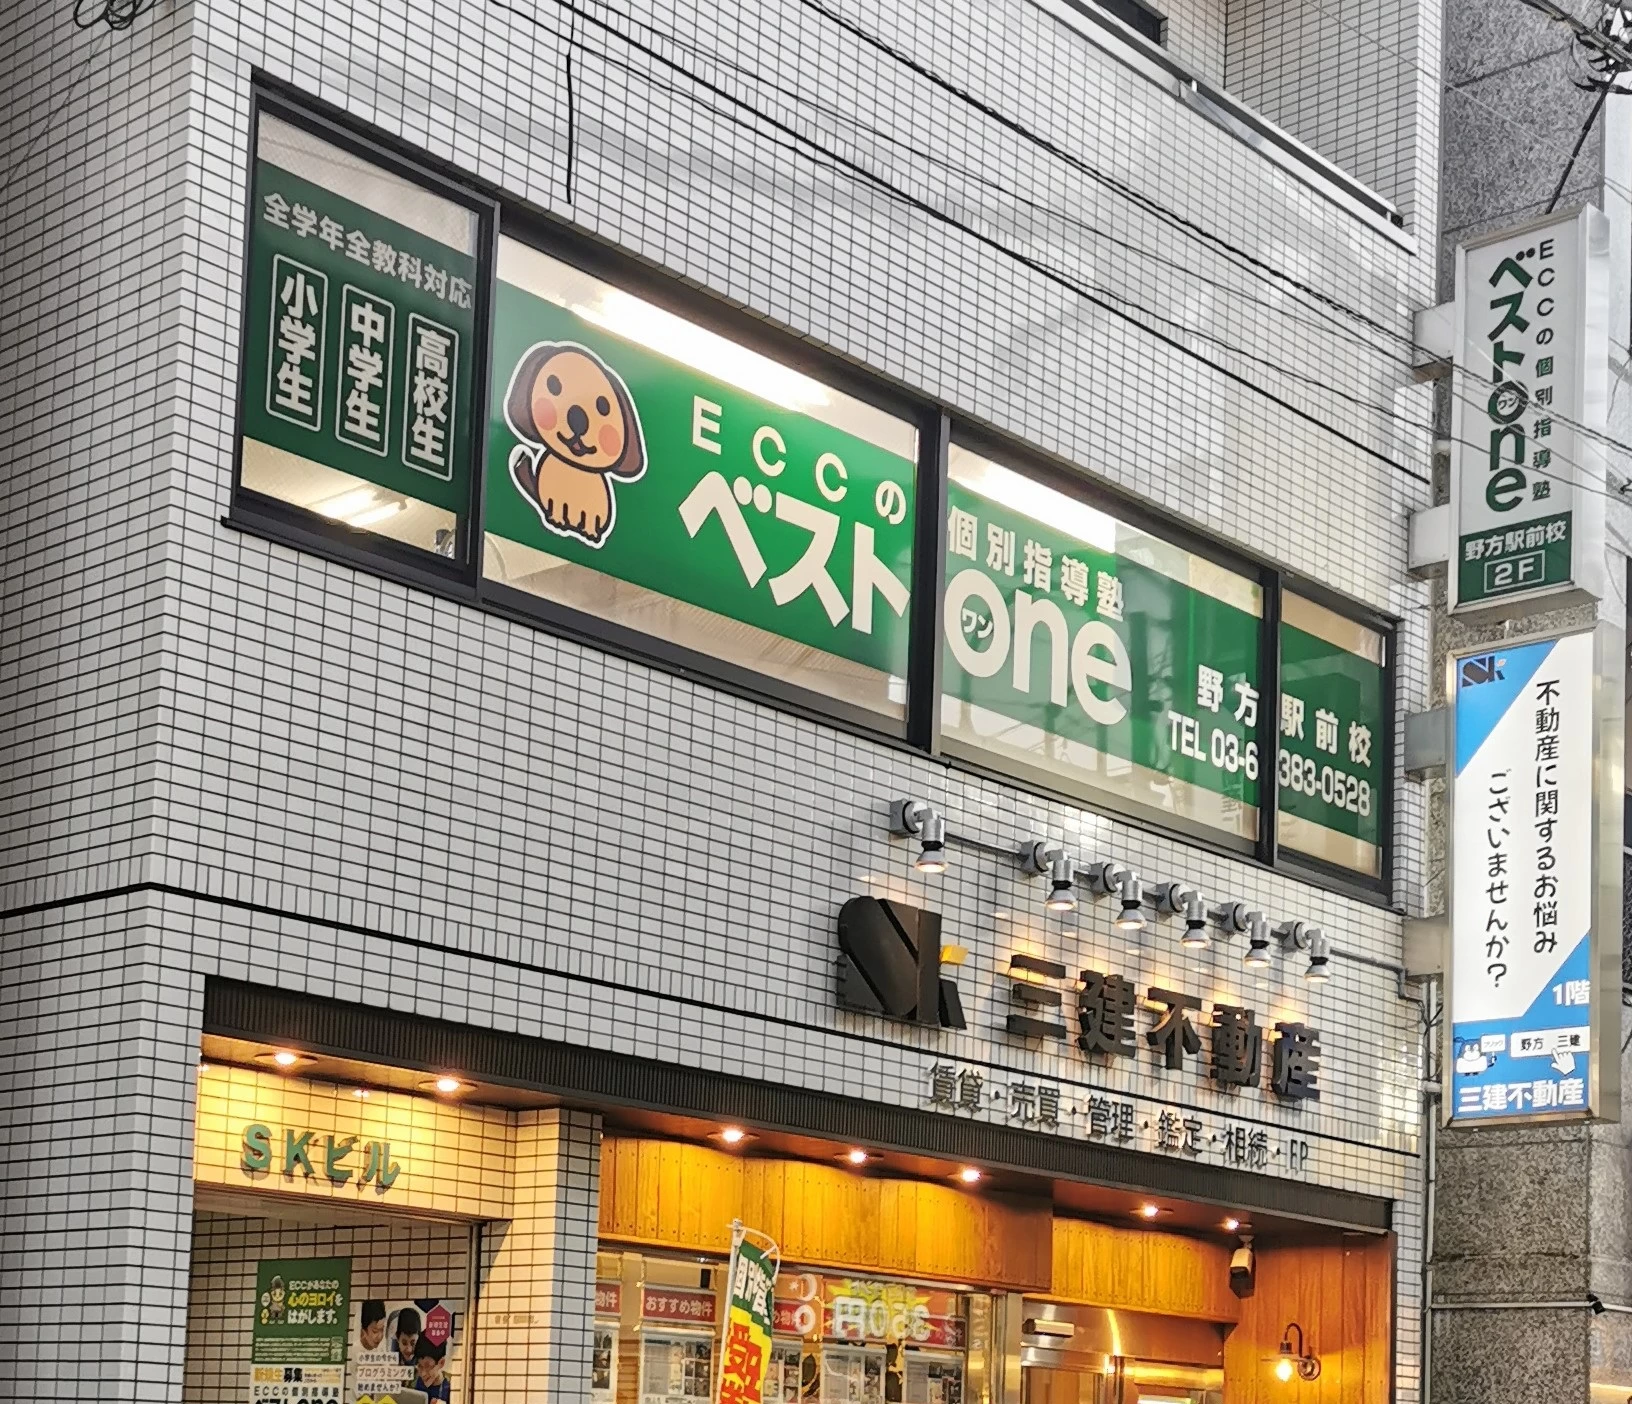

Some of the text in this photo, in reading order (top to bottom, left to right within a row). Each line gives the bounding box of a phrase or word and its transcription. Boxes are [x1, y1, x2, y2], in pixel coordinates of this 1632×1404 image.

[263, 192, 472, 310] 全学年全教科対応
[275, 272, 319, 416] 小学生
[345, 301, 386, 443] 中学生
[410, 326, 452, 467] 高校生
[692, 395, 1125, 622] ECCの 個別指導塾
[1465, 519, 1567, 562] 野方駅前校
[678, 470, 1133, 726] ベスト one
[1494, 557, 1536, 586] 2F
[961, 607, 994, 639] ワン
[1167, 709, 1207, 762] TEL
[1197, 664, 1373, 769] 野方 駅前校
[1532, 679, 1561, 954] 不動産に関するお悩み
[1006, 953, 1321, 1101] 三建不動産
[1552, 979, 1591, 1006] 1階
[1520, 1034, 1581, 1051] 野方 三建
[1457, 1078, 1585, 1113] 三建不動産
[242, 1123, 401, 1188] SKビル
[645, 1295, 713, 1318] おすすめ物件
